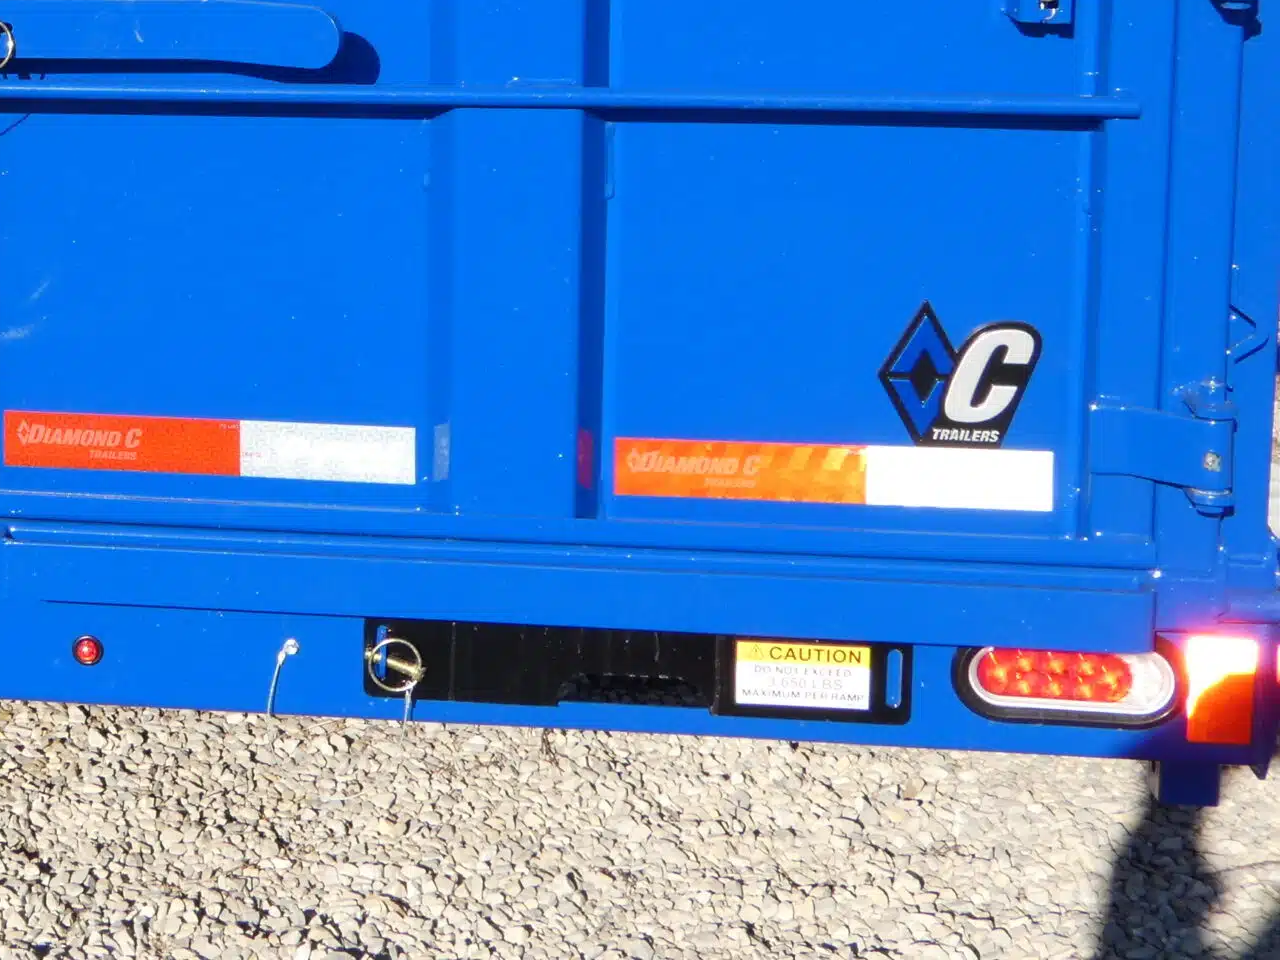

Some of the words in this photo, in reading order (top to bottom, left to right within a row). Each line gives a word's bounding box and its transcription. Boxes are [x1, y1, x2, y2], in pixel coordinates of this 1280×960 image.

[943, 328, 1036, 424] C
[27, 423, 122, 448] DIAMOND
[124, 428, 143, 449] C
[932, 427, 1000, 443] TRAILERS
[89, 449, 137, 461] TRAILERS
[641, 450, 740, 475] DIAMOND
[742, 455, 762, 476] C
[769, 646, 862, 664] CAUTION
[742, 688, 801, 699] MAXIMUM
